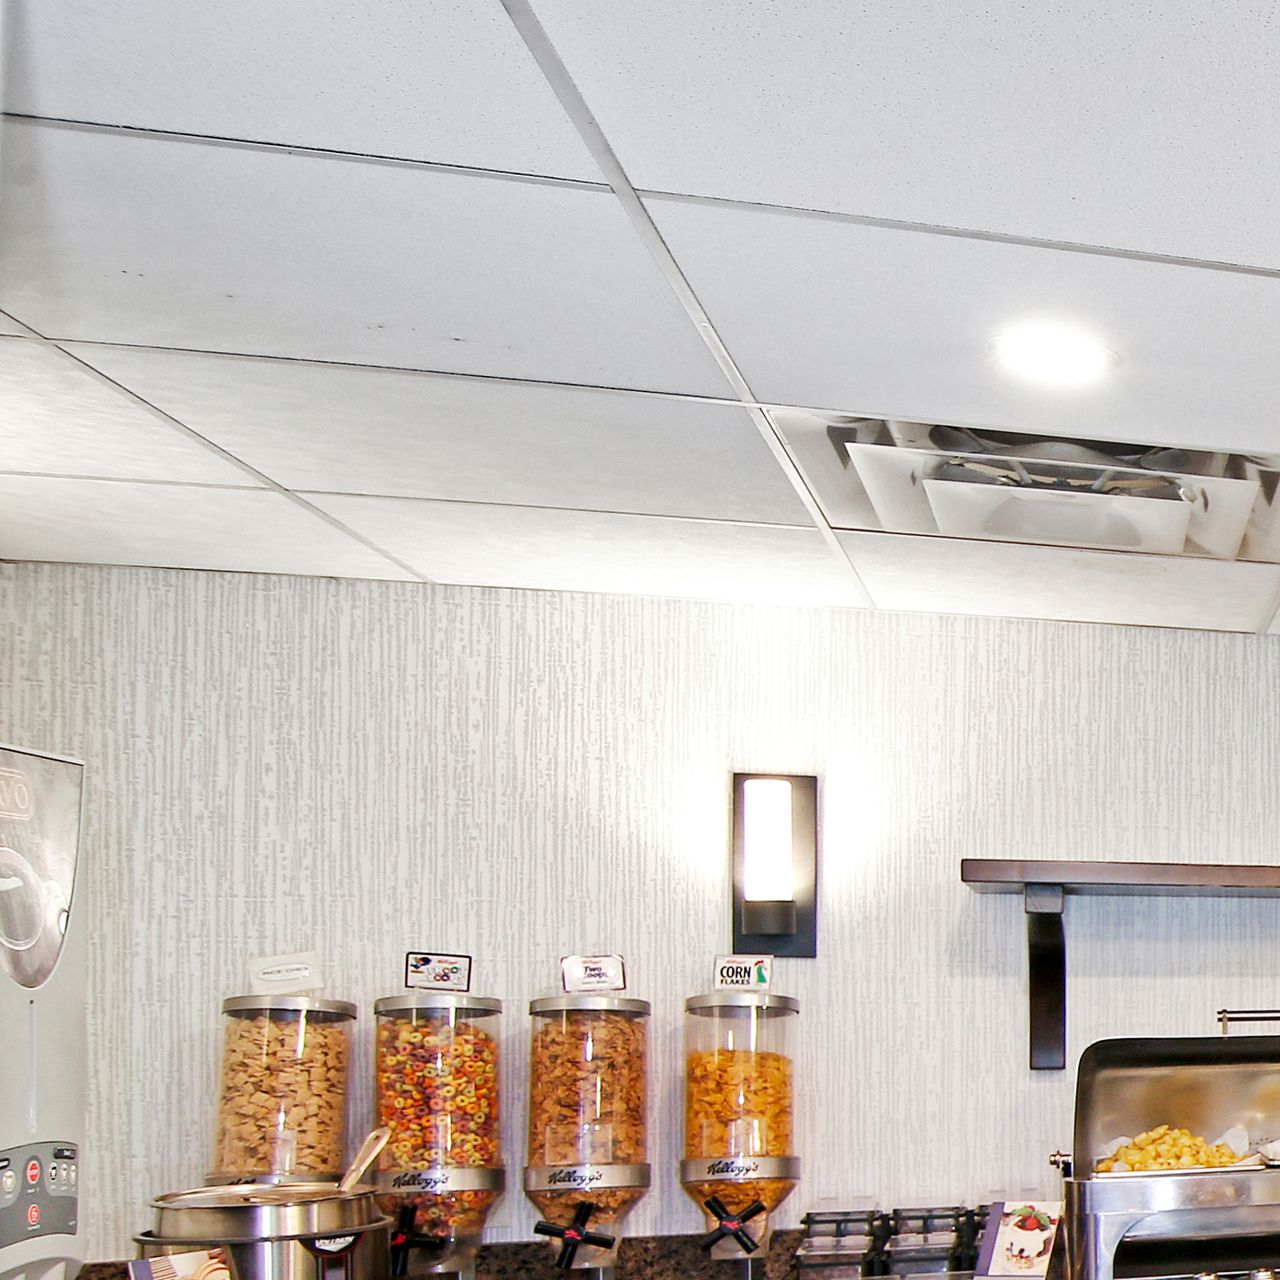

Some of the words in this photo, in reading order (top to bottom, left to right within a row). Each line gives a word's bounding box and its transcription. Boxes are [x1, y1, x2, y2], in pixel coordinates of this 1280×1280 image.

[720, 966, 752, 979] CORN
[706, 1160, 760, 1177] Kellogg's
[392, 1172, 449, 1190] Kellogg's
[548, 1169, 603, 1187] Kellogg's
